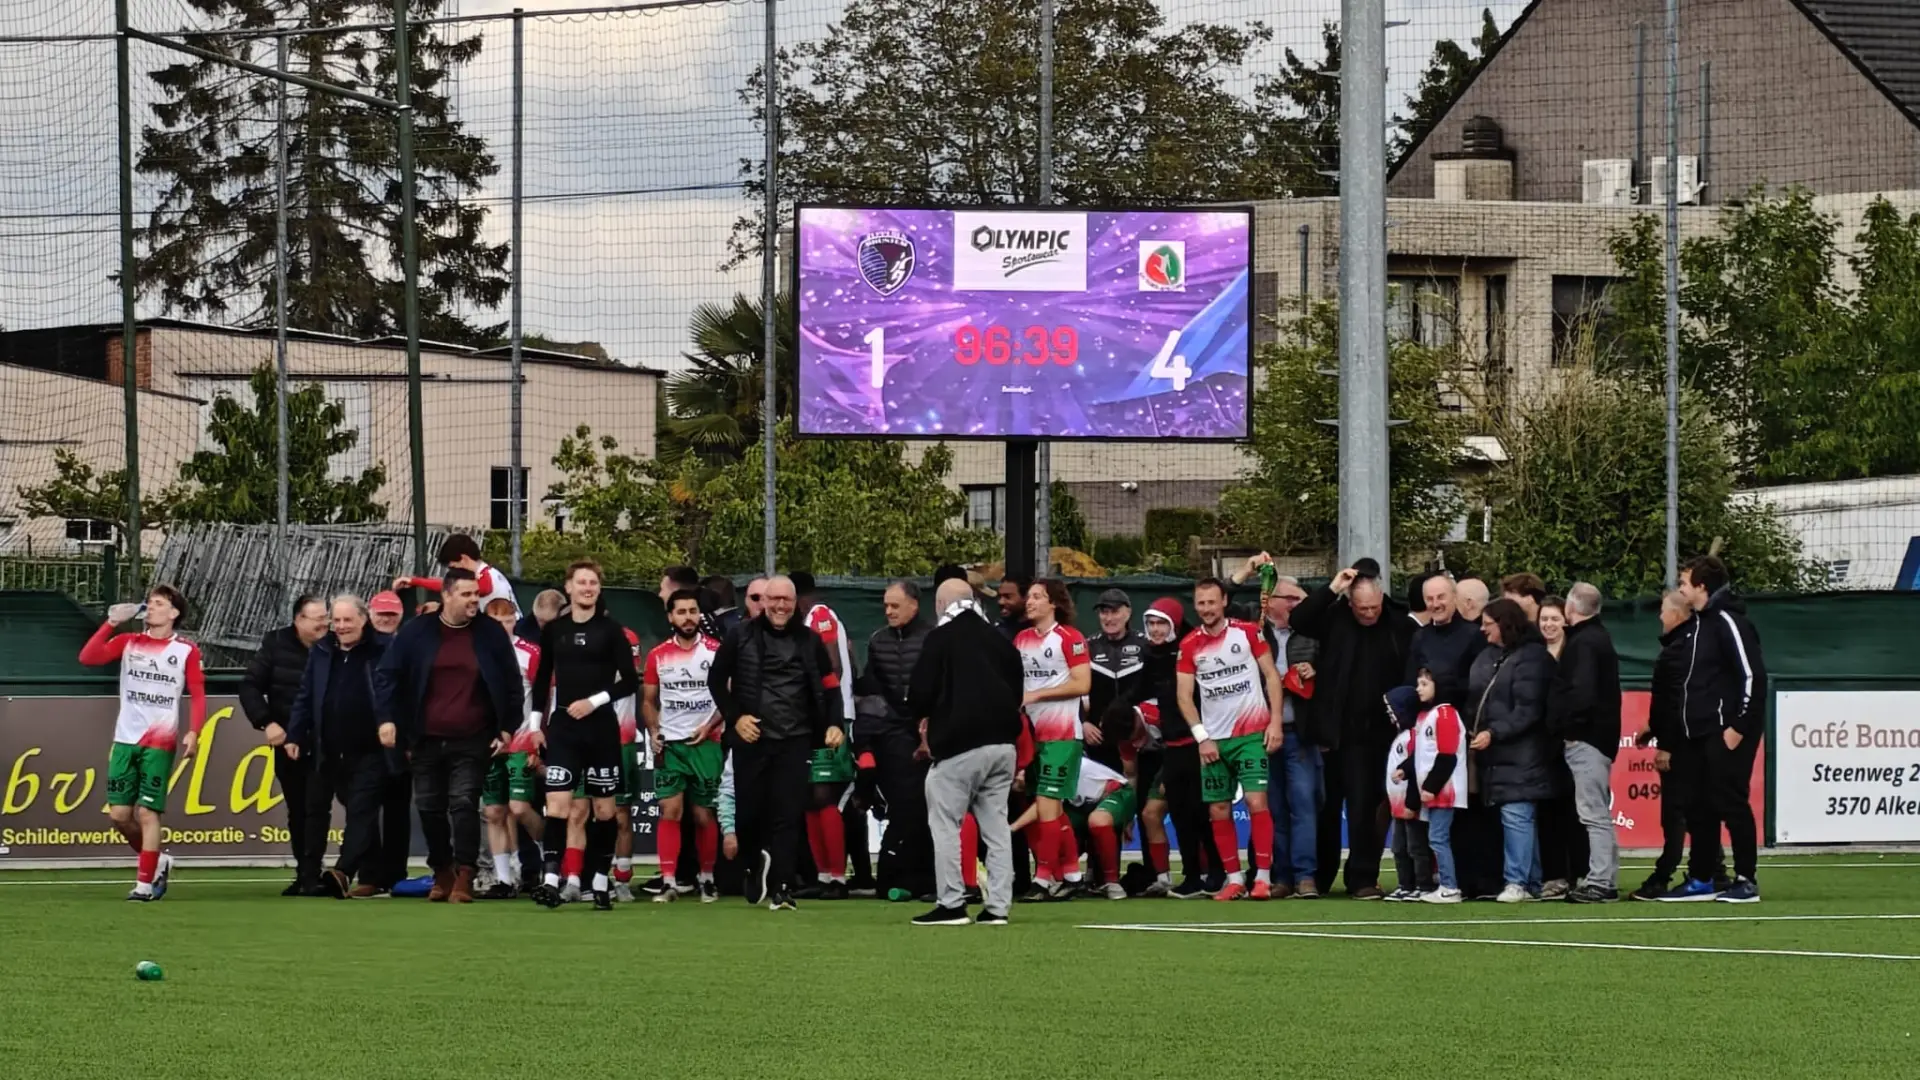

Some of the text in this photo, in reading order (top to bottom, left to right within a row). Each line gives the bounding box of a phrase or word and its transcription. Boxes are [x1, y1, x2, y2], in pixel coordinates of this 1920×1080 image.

[971, 225, 1070, 252] OLYMPIC
[1002, 249, 1060, 268] Sportswear
[954, 325, 1079, 366] 96:39
[864, 327, 884, 389] 1
[1151, 329, 1193, 391] 4
[127, 668, 178, 684] ALTEBRA
[1790, 720, 1920, 748] Café Bana
[1812, 763, 1905, 787] Steenweg
[1628, 783, 1661, 800] 049
[1232, 811, 1250, 821] PA
[1825, 795, 1920, 815] 3570 Alke
[160, 826, 244, 844] Decoratie
